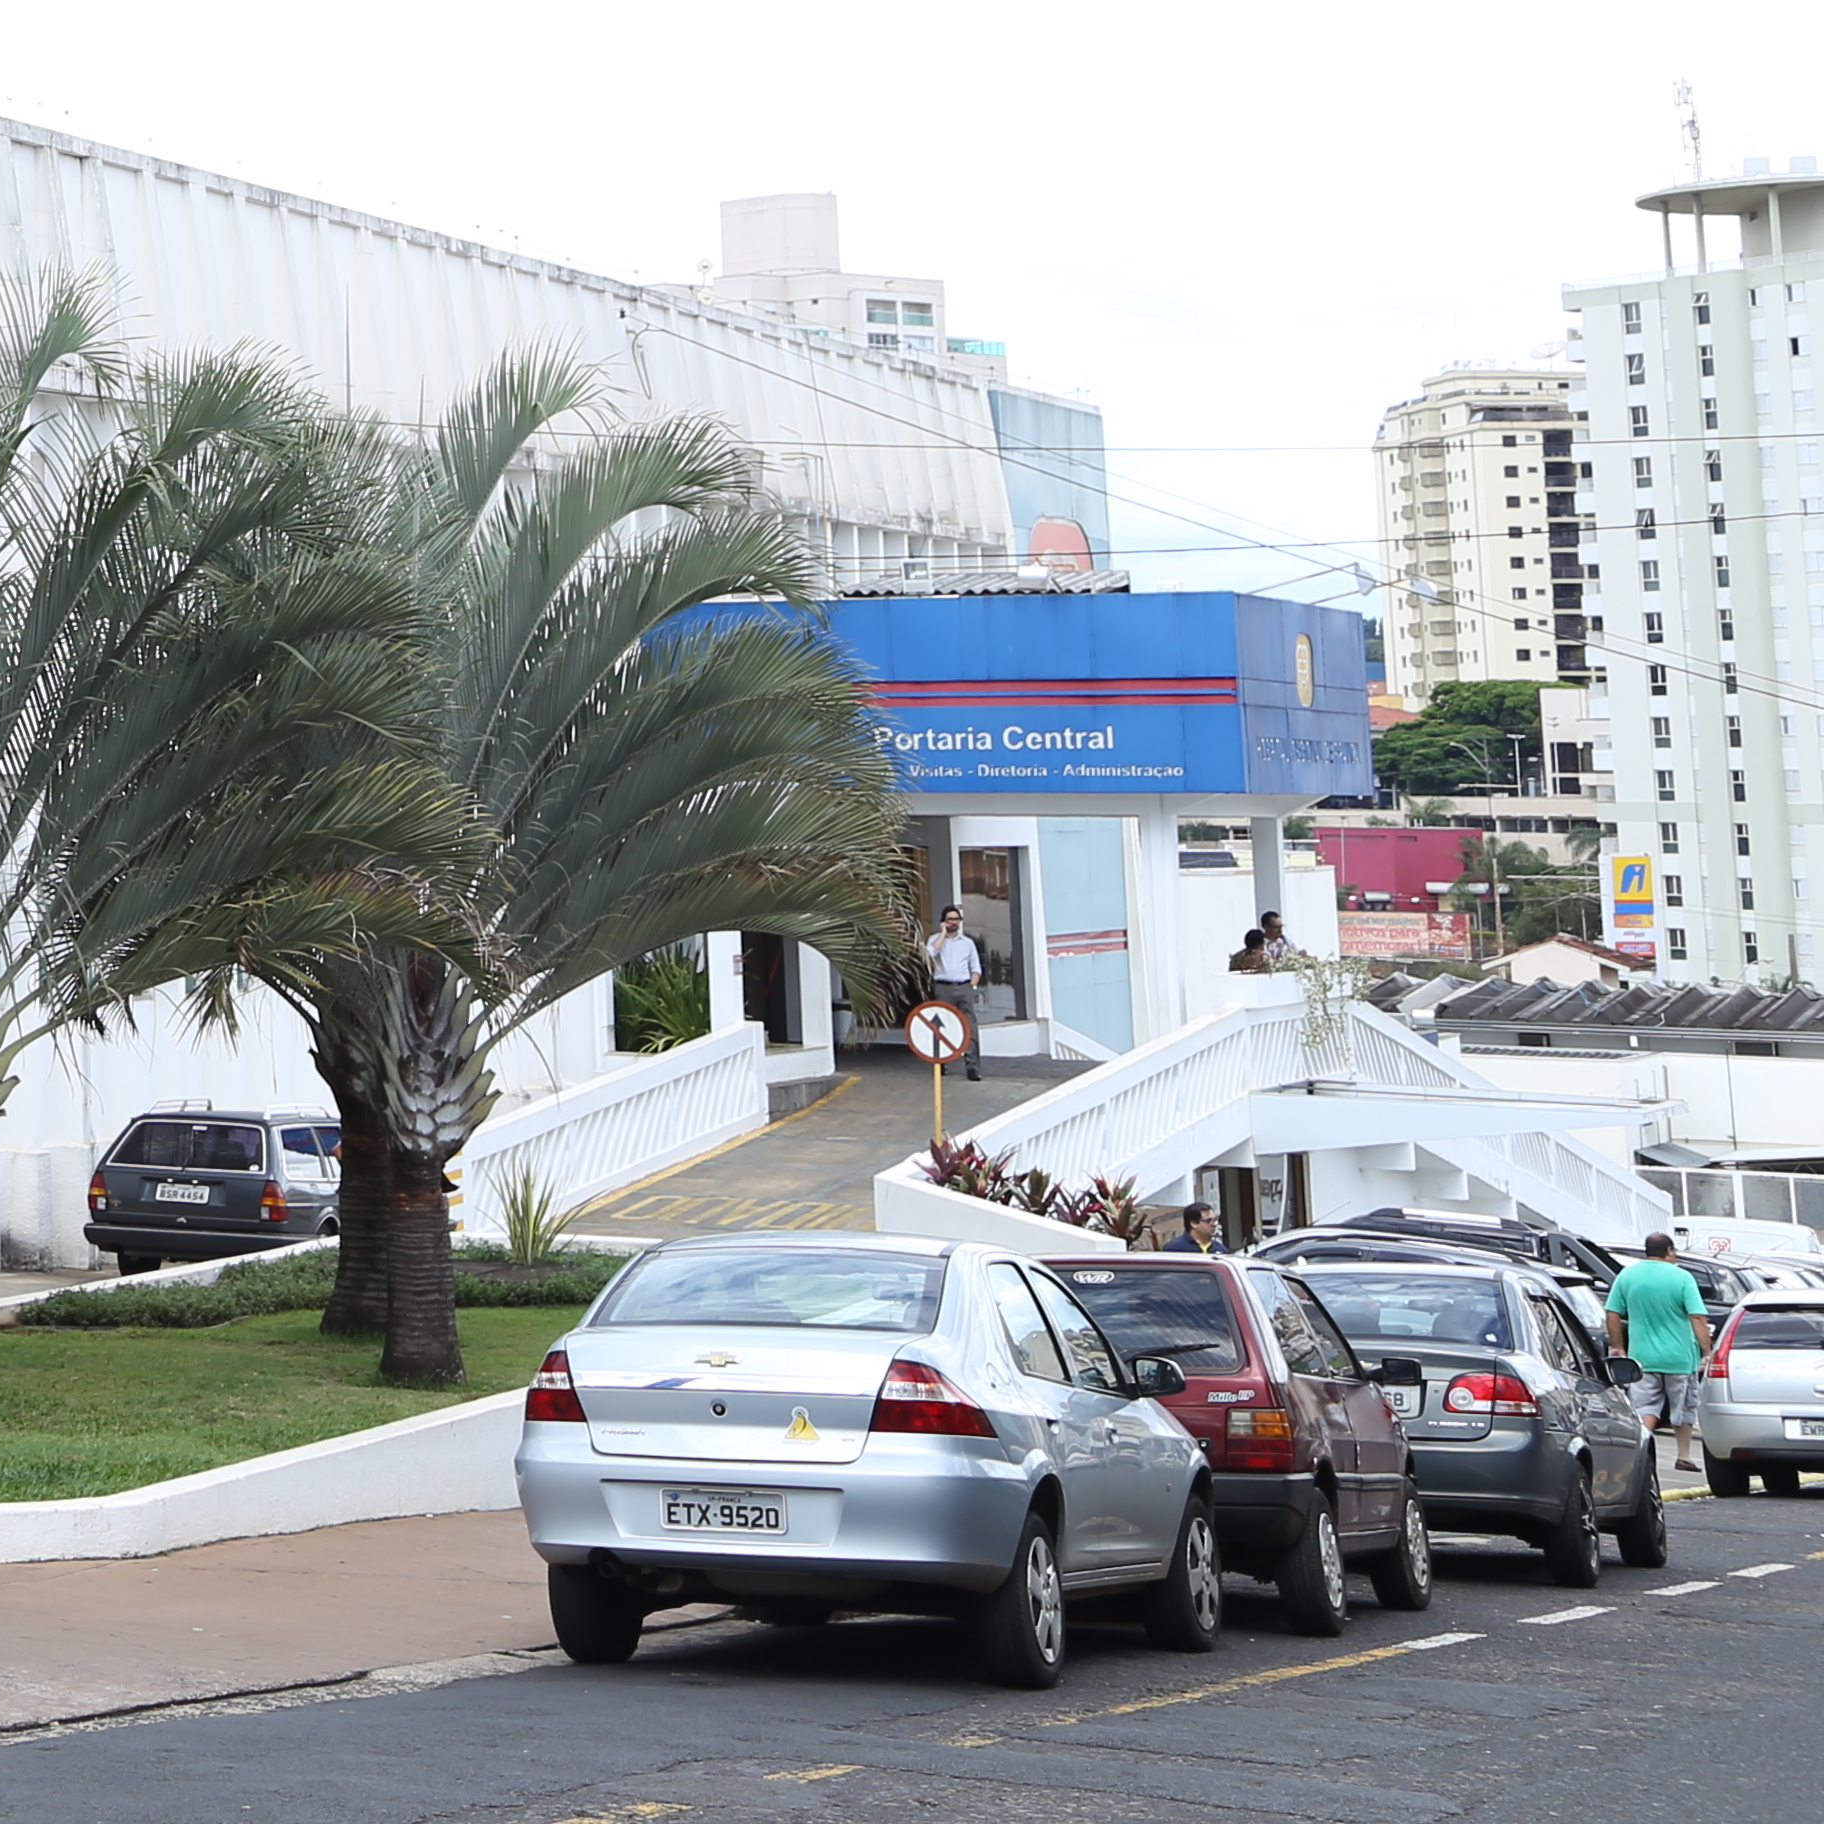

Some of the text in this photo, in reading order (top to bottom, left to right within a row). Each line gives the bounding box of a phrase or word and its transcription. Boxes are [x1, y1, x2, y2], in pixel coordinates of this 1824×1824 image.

[872, 726, 1114, 751] Portaria Central
[909, 764, 963, 777] Visitas
[977, 763, 1048, 777] Diretoria
[1063, 764, 1184, 780] Administração
[1207, 1391, 1238, 1403] Mille
